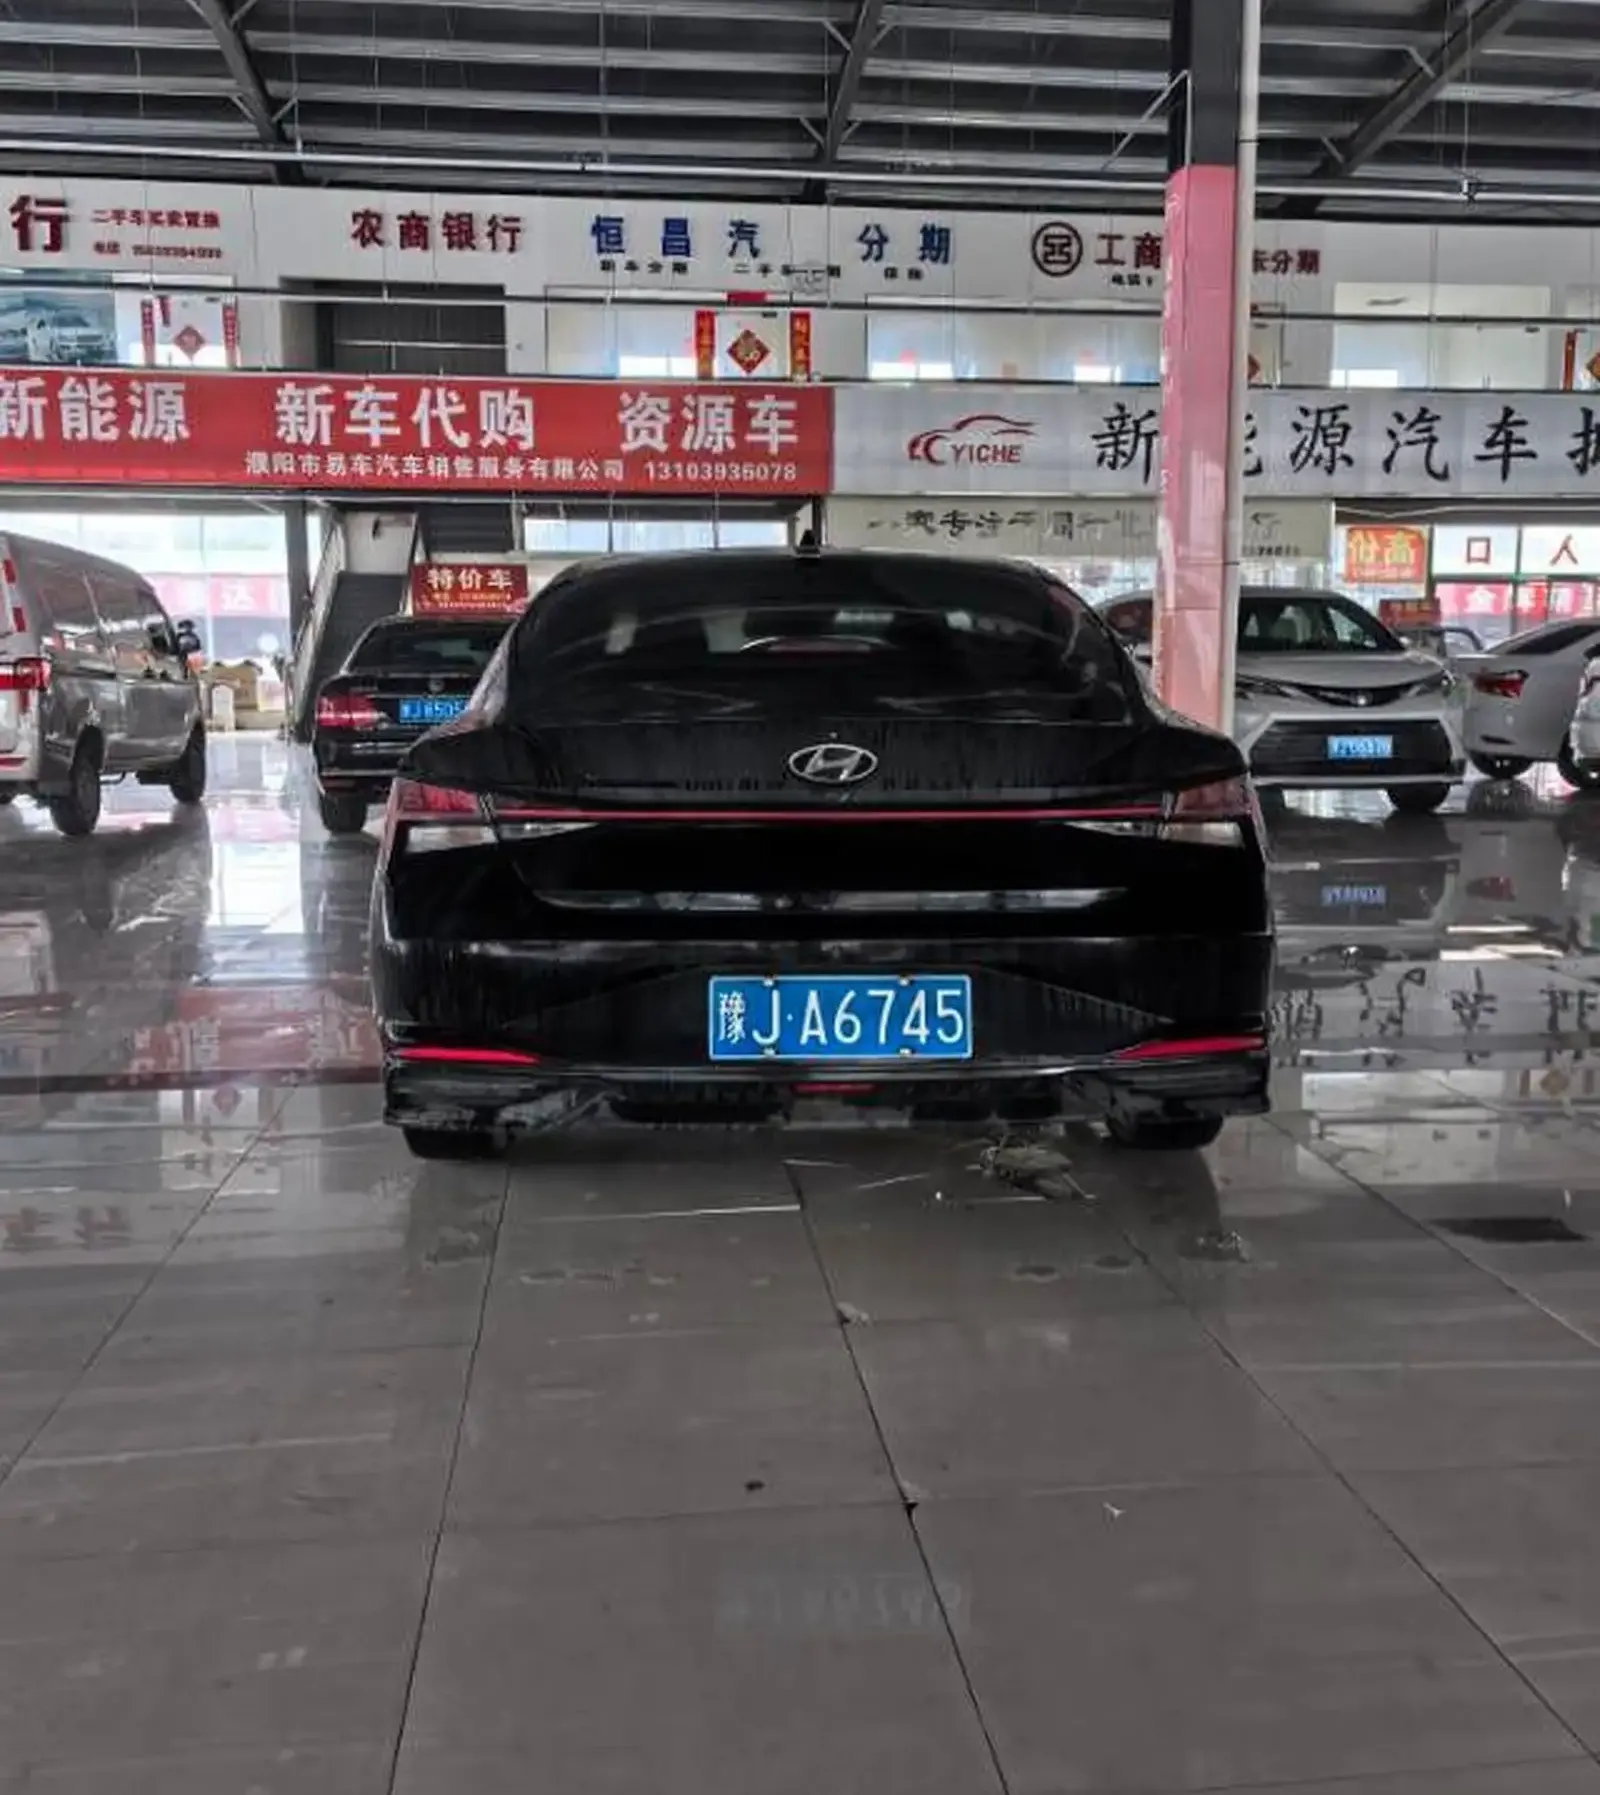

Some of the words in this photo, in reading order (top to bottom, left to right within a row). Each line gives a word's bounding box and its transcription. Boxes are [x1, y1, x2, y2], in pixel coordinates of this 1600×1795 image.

[9, 195, 71, 253] 行
[351, 208, 523, 254] 农商银行
[0, 377, 190, 443] 新能源
[275, 381, 535, 451] 新车代购
[617, 390, 799, 456] 资源车
[950, 442, 1023, 464] YICHE
[426, 566, 514, 591] 特价车
